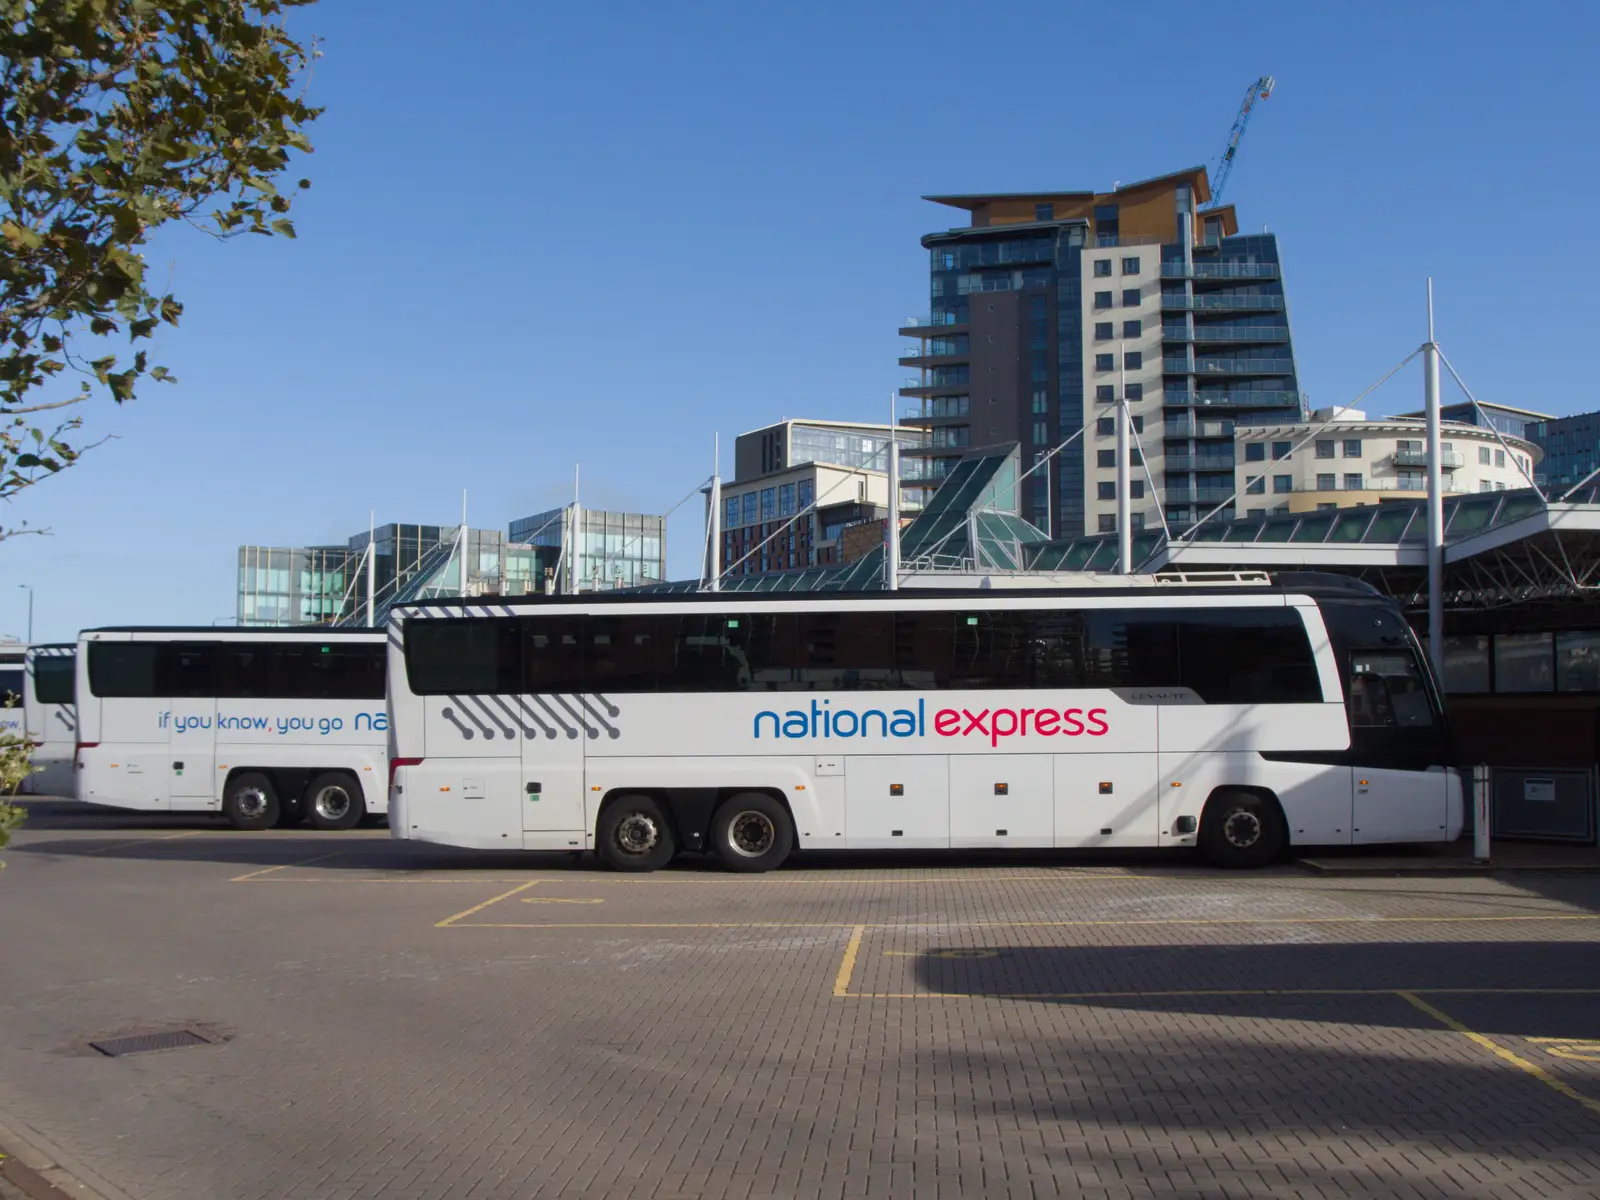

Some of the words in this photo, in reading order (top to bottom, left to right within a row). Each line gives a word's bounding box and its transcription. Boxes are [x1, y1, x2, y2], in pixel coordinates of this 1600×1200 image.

[1131, 692, 1189, 700] LEVANTE
[158, 711, 171, 728] if
[175, 716, 212, 733] you
[217, 712, 272, 732] know,
[277, 717, 314, 735] you
[318, 717, 343, 735] go
[754, 698, 925, 738] national
[934, 708, 1109, 748] express
